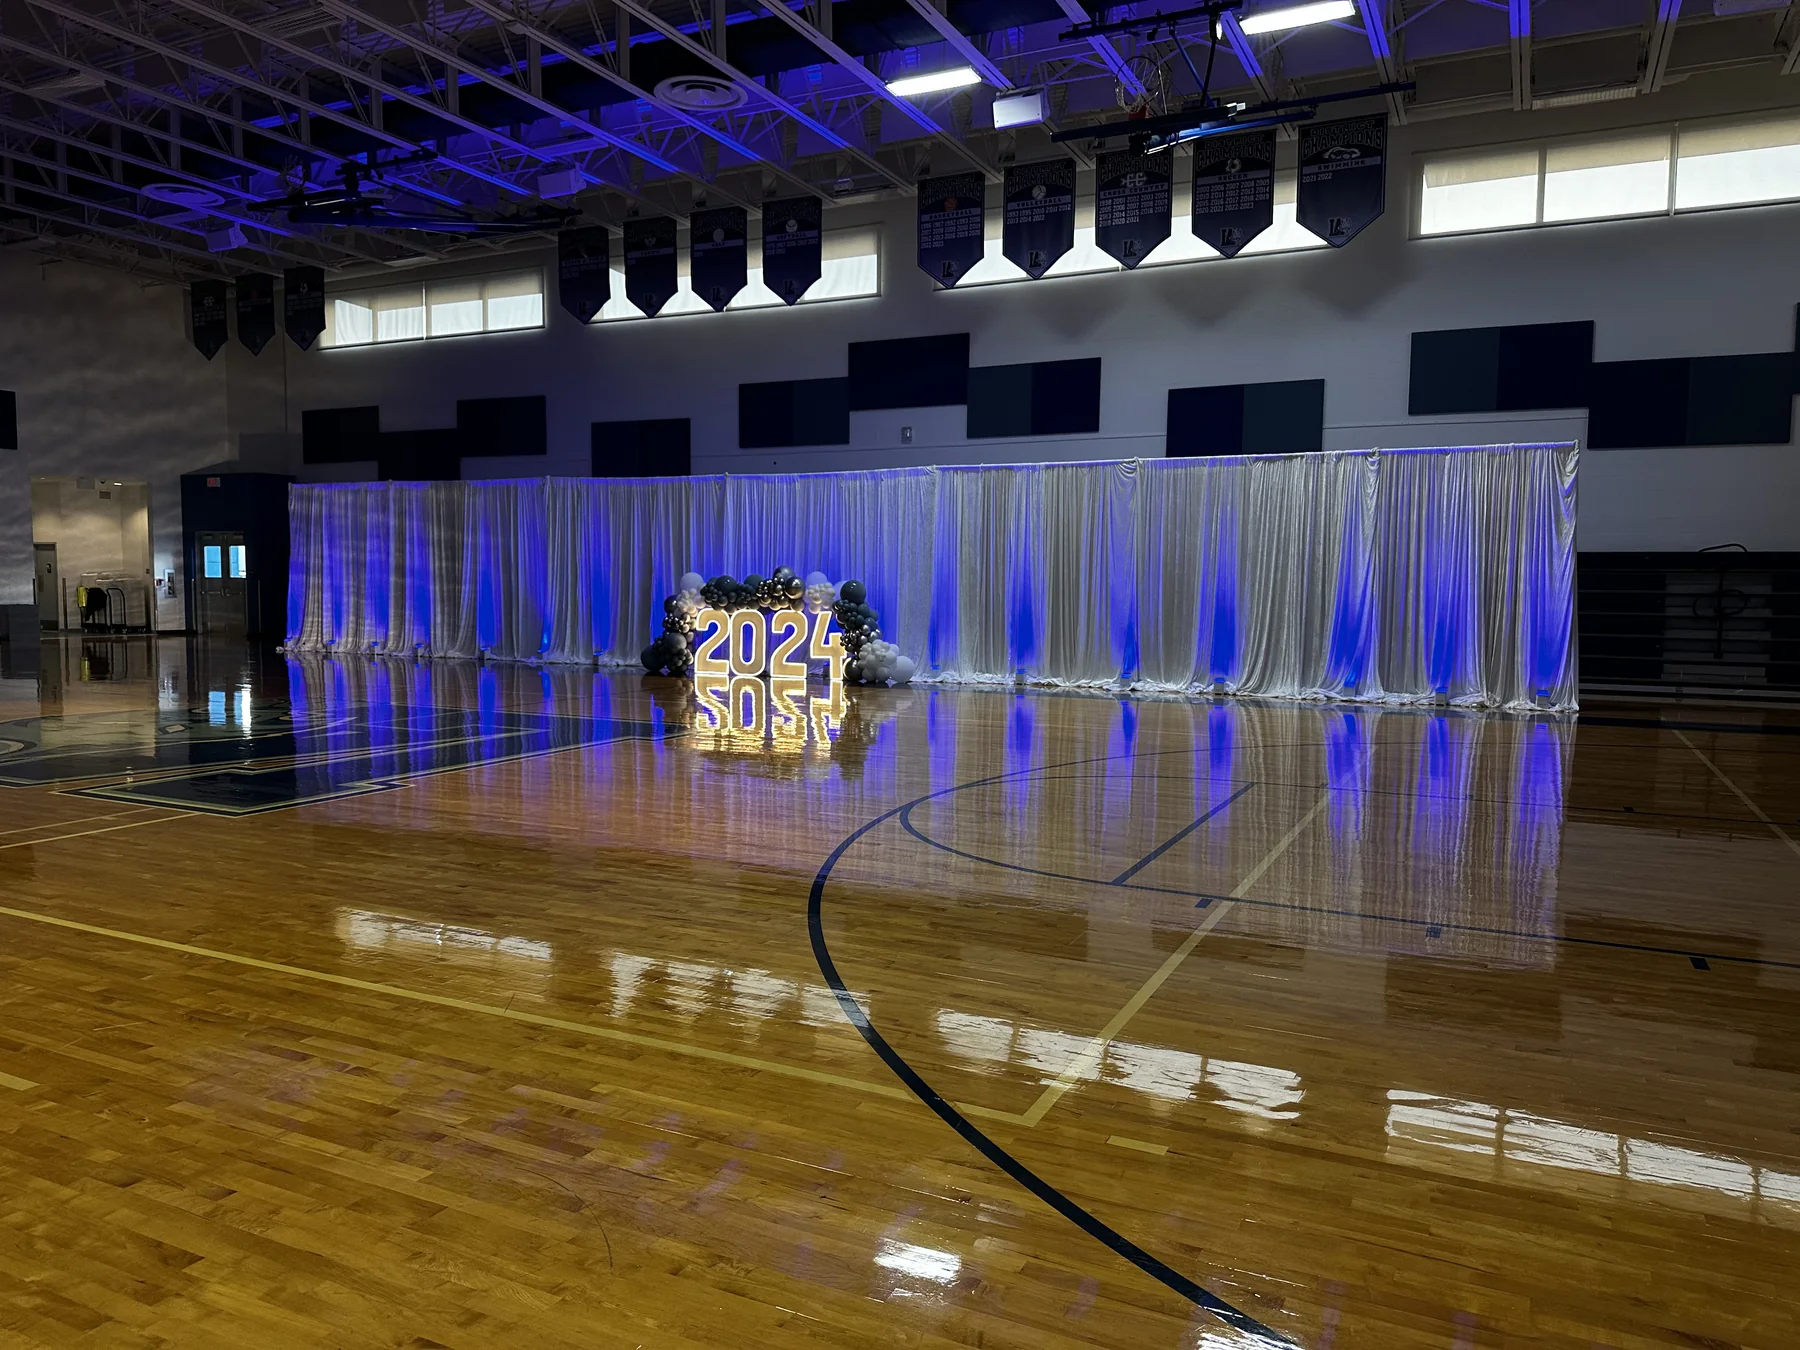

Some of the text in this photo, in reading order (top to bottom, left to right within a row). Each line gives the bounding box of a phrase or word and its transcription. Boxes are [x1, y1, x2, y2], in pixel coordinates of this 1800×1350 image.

[1204, 133, 1264, 149] DISTRICT
[1310, 120, 1375, 137] DISTRICT
[1196, 141, 1272, 172] CHAMPIONS
[1302, 126, 1382, 160] CHAMPIONS
[1099, 156, 1169, 185] CHAMPIONS
[1318, 160, 1365, 171] SWIMMING
[921, 181, 981, 209] CHAMPIONS
[1007, 168, 1072, 197] CHAMPIONS
[1130, 185, 1164, 193] COUNTRY
[1016, 198, 1061, 207] VOLLEYBALL
[694, 608, 847, 680] 2024
